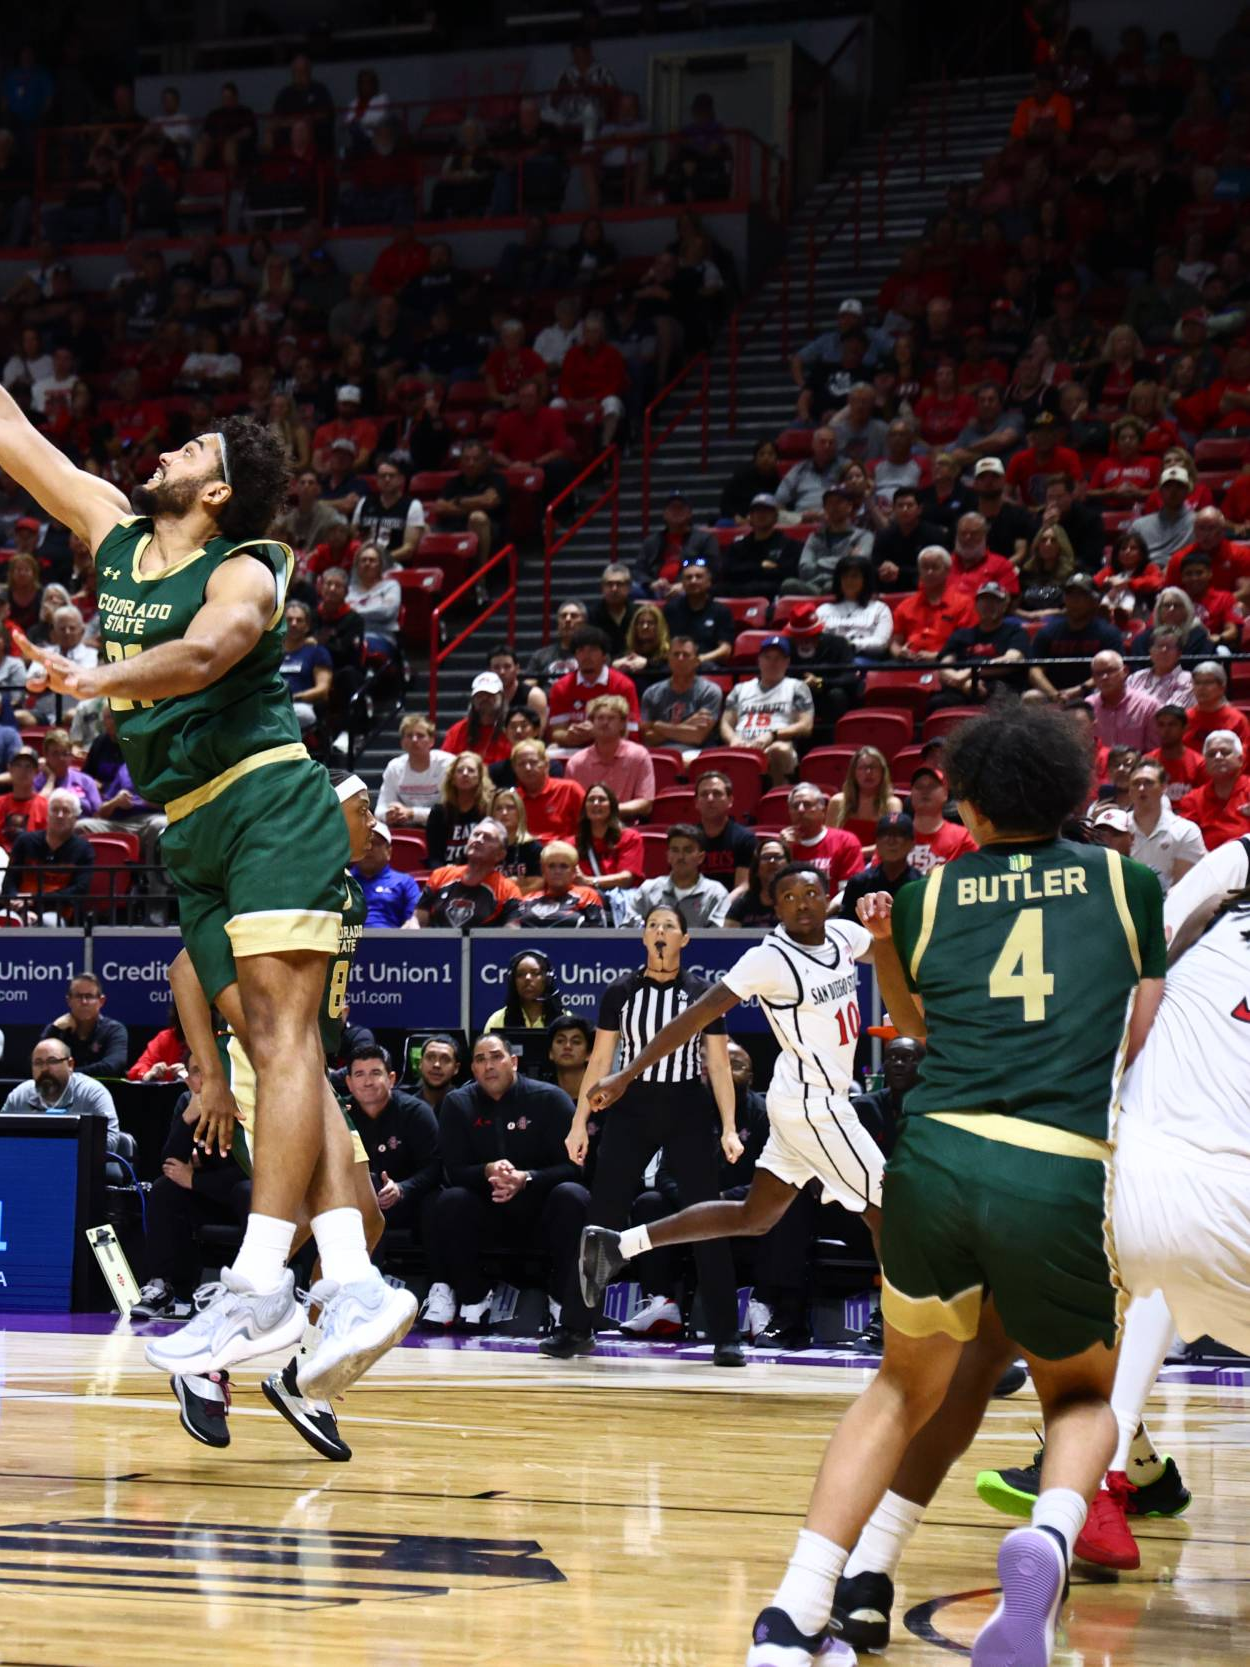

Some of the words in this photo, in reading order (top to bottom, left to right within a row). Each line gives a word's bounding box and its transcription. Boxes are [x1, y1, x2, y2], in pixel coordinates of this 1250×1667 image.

[104, 614, 146, 635] STATE
[957, 866, 1088, 906] BUTLER
[66, 961, 75, 981] 1
[102, 961, 170, 981] Credit
[369, 961, 439, 983] Union
[442, 963, 452, 983] 1
[989, 907, 1054, 1023] 4
[810, 984, 829, 1005] SAN
[827, 978, 848, 1001] DIEGO
[833, 1001, 861, 1047] 10
